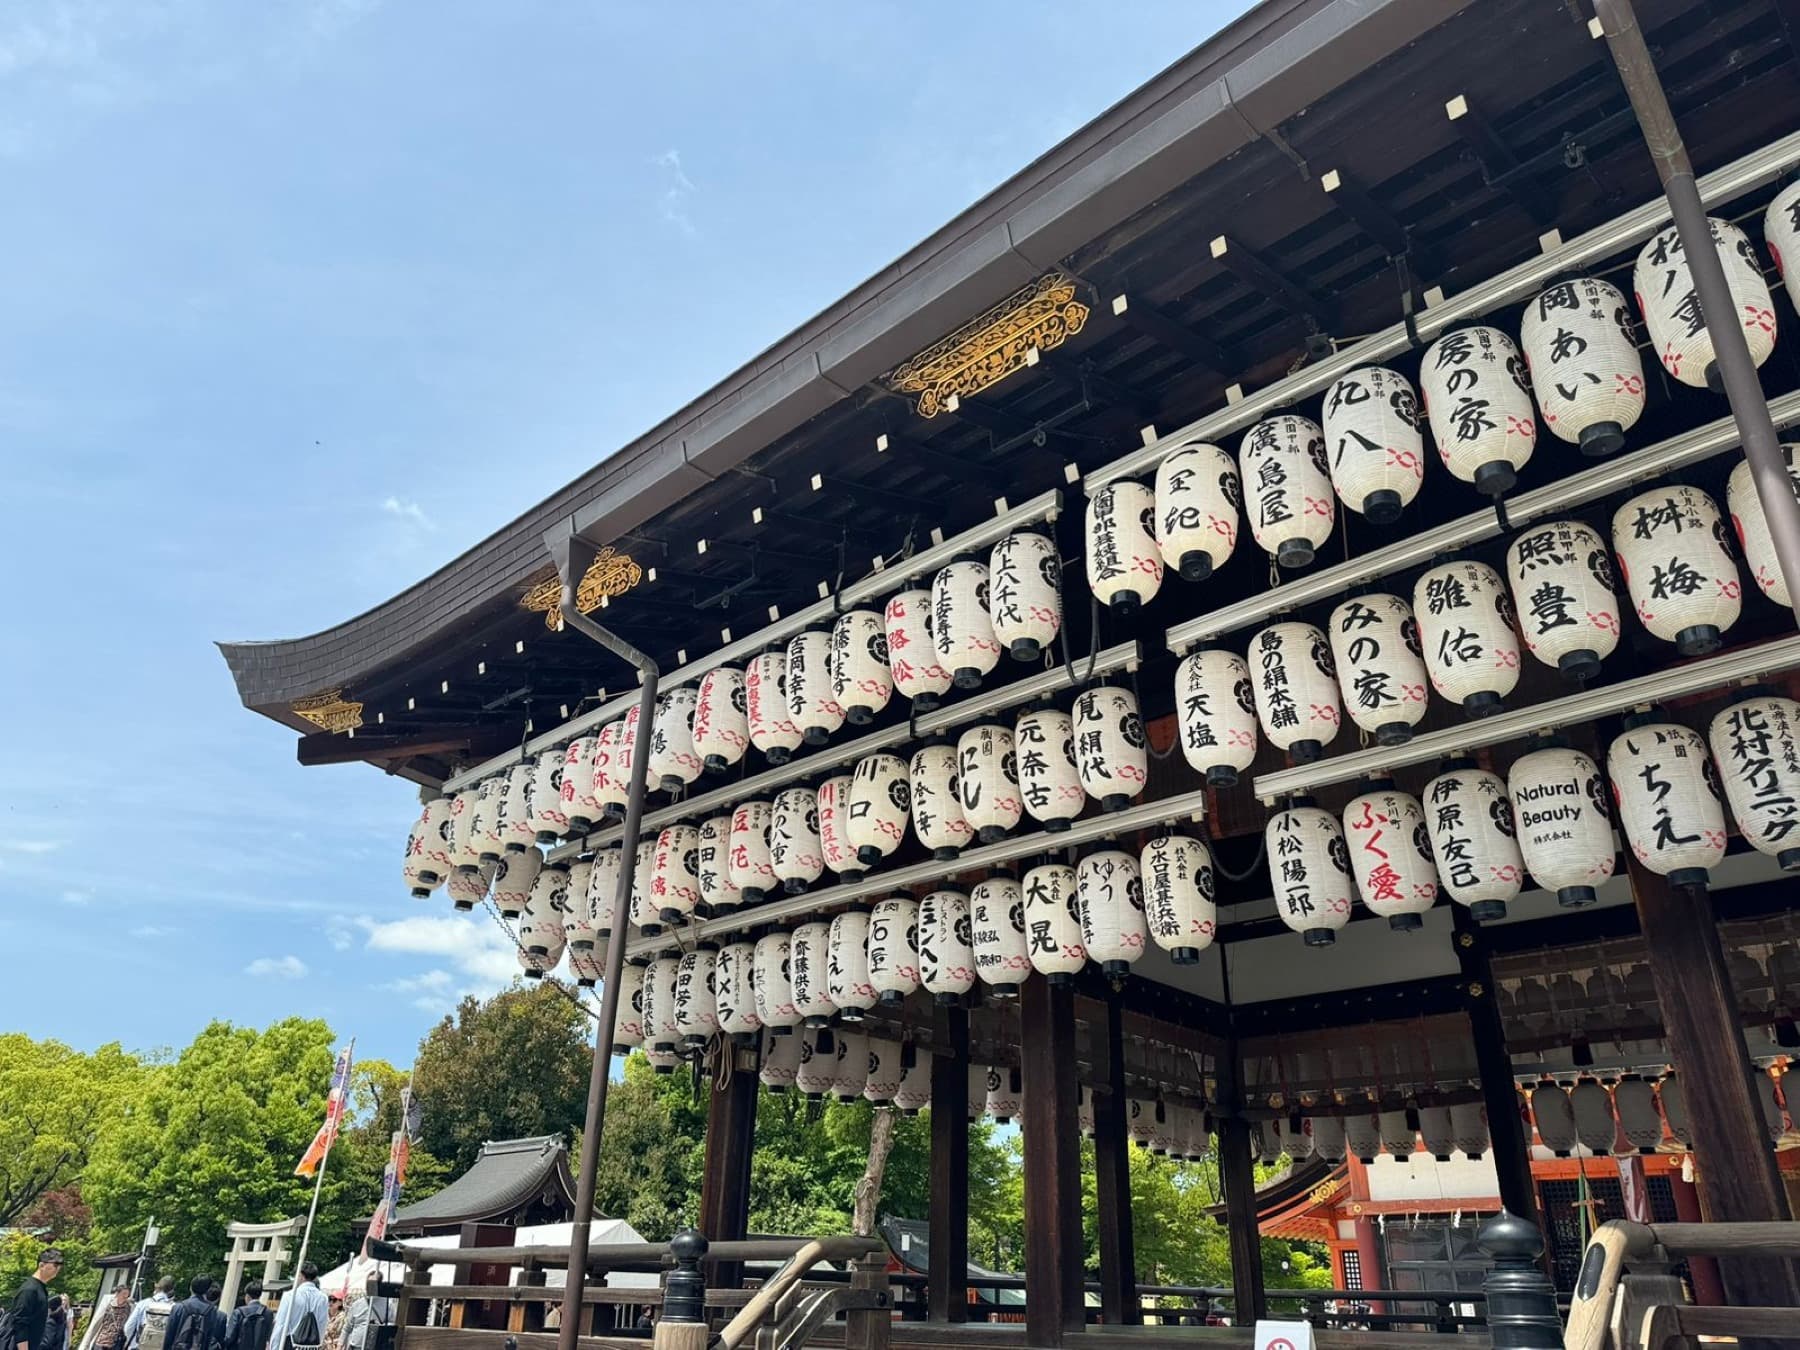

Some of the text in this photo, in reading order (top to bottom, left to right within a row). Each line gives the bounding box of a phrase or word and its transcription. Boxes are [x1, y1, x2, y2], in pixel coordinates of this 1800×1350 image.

[1435, 332, 1498, 443] 房の家
[1538, 282, 1602, 401] 岡あい
[994, 534, 1023, 627] 井上八千代
[1518, 531, 1578, 636] 照豊
[788, 636, 808, 715] 吉岡幸子
[1341, 602, 1399, 709] みの家
[1019, 719, 1052, 809] 元奈古
[1184, 693, 1219, 750] 天塩
[850, 758, 878, 820] 川口
[1515, 777, 1580, 806] Natural
[1521, 804, 1582, 828] Beauty
[1626, 731, 1702, 850] いちえ
[1725, 707, 1800, 842] 北村クリニック
[1276, 812, 1315, 918] 小松陽一郎
[1352, 801, 1405, 901] ふく愛
[1533, 830, 1573, 845] 株式会社
[717, 950, 734, 1023] キメラ
